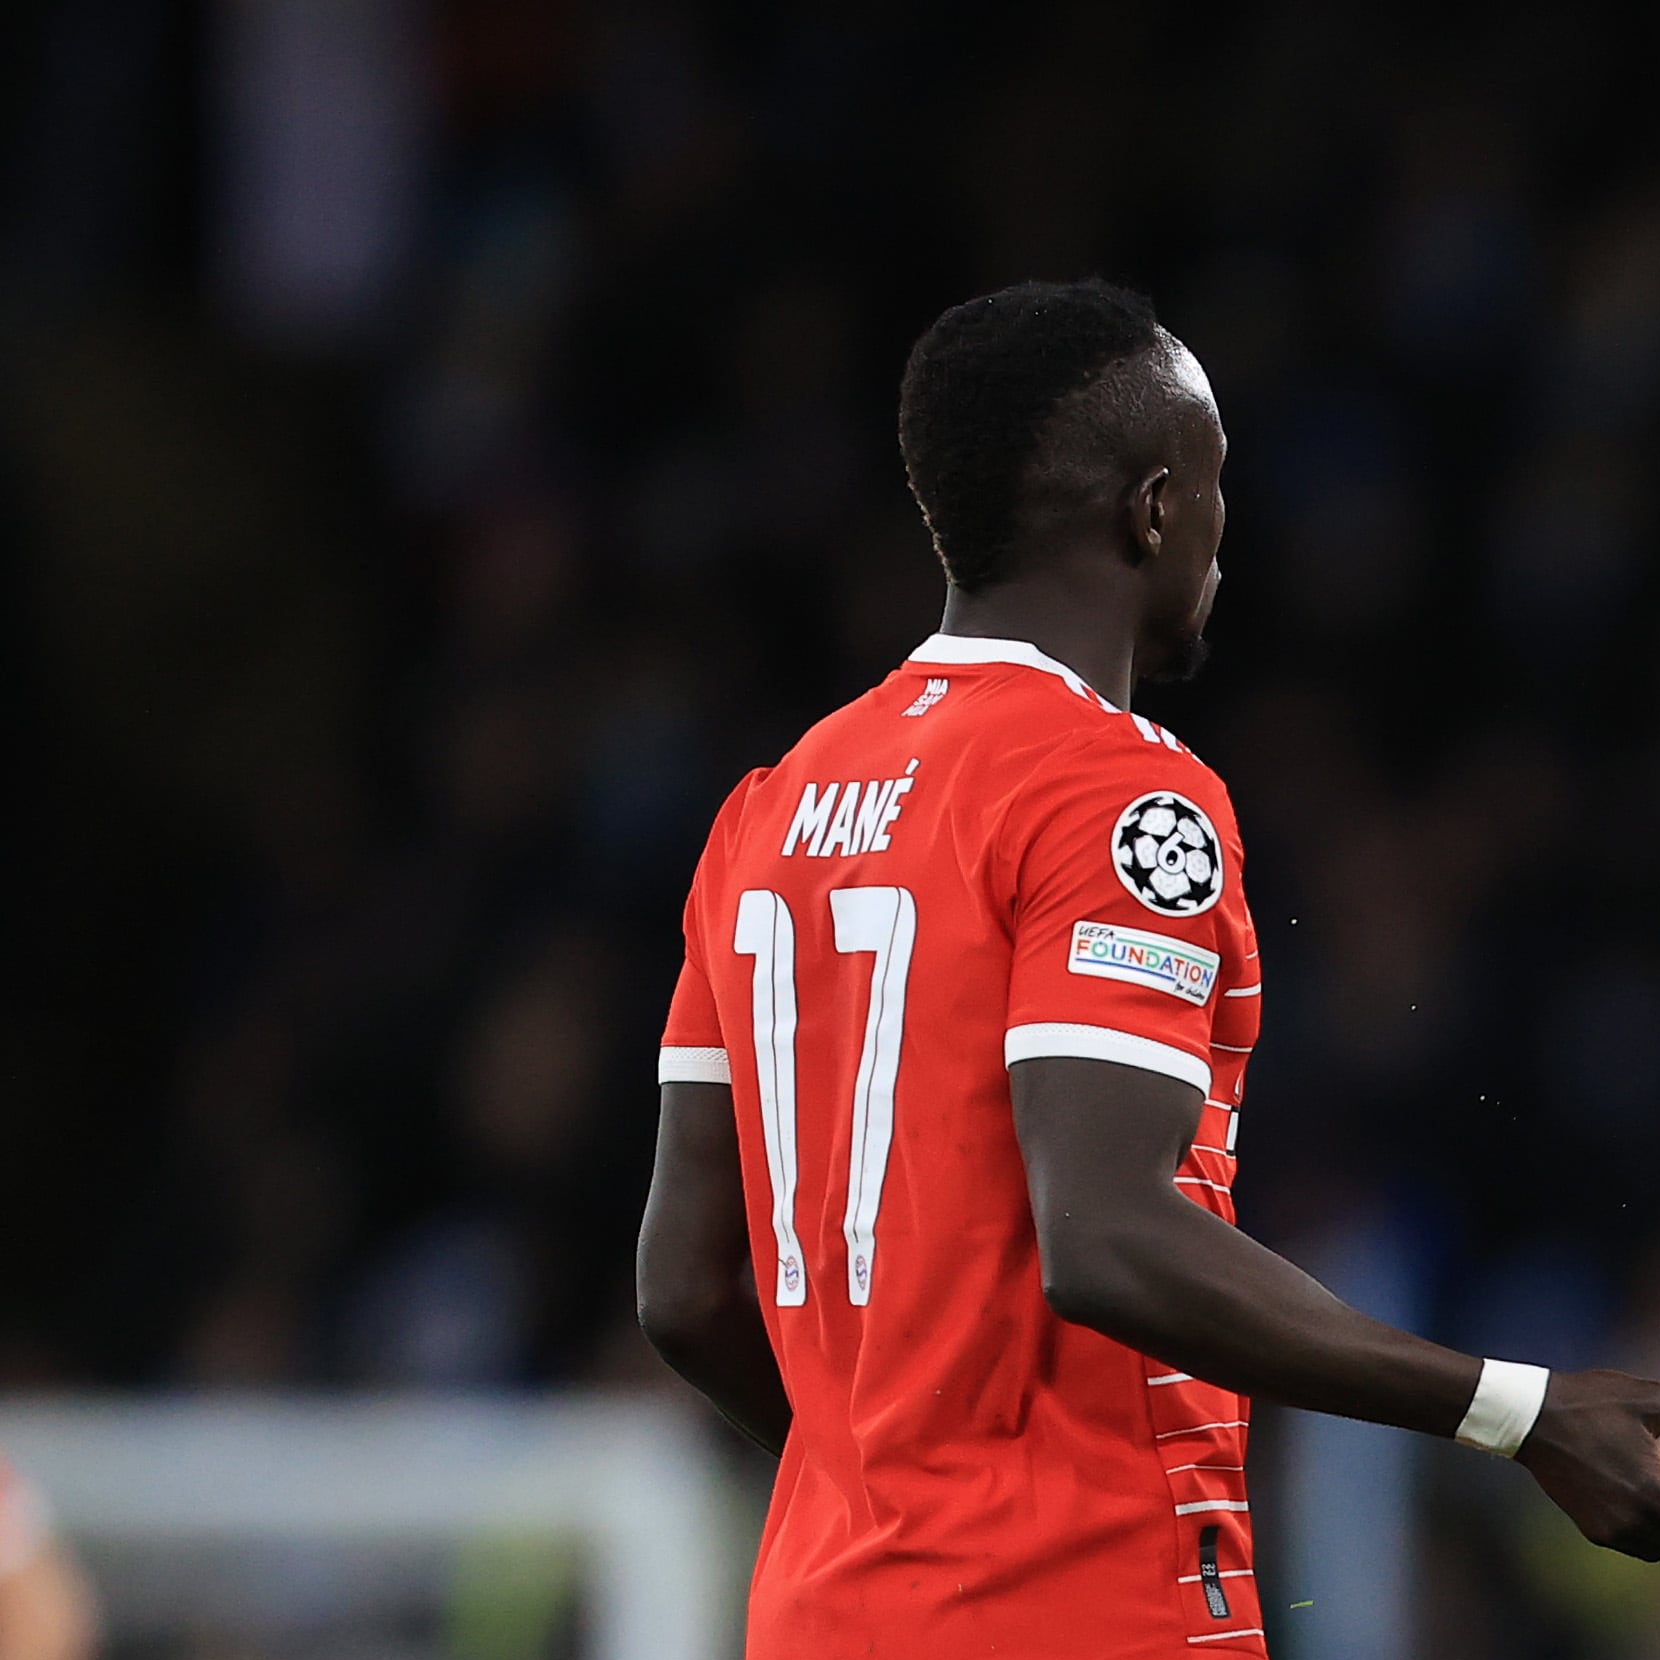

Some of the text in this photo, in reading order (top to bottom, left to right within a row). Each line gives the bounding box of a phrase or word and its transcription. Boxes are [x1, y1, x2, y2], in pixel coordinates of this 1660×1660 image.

[780, 757, 921, 858] MANÉ
[1156, 831, 1187, 875] 6
[1078, 924, 1116, 940] UEFA
[733, 886, 918, 1307] 17
